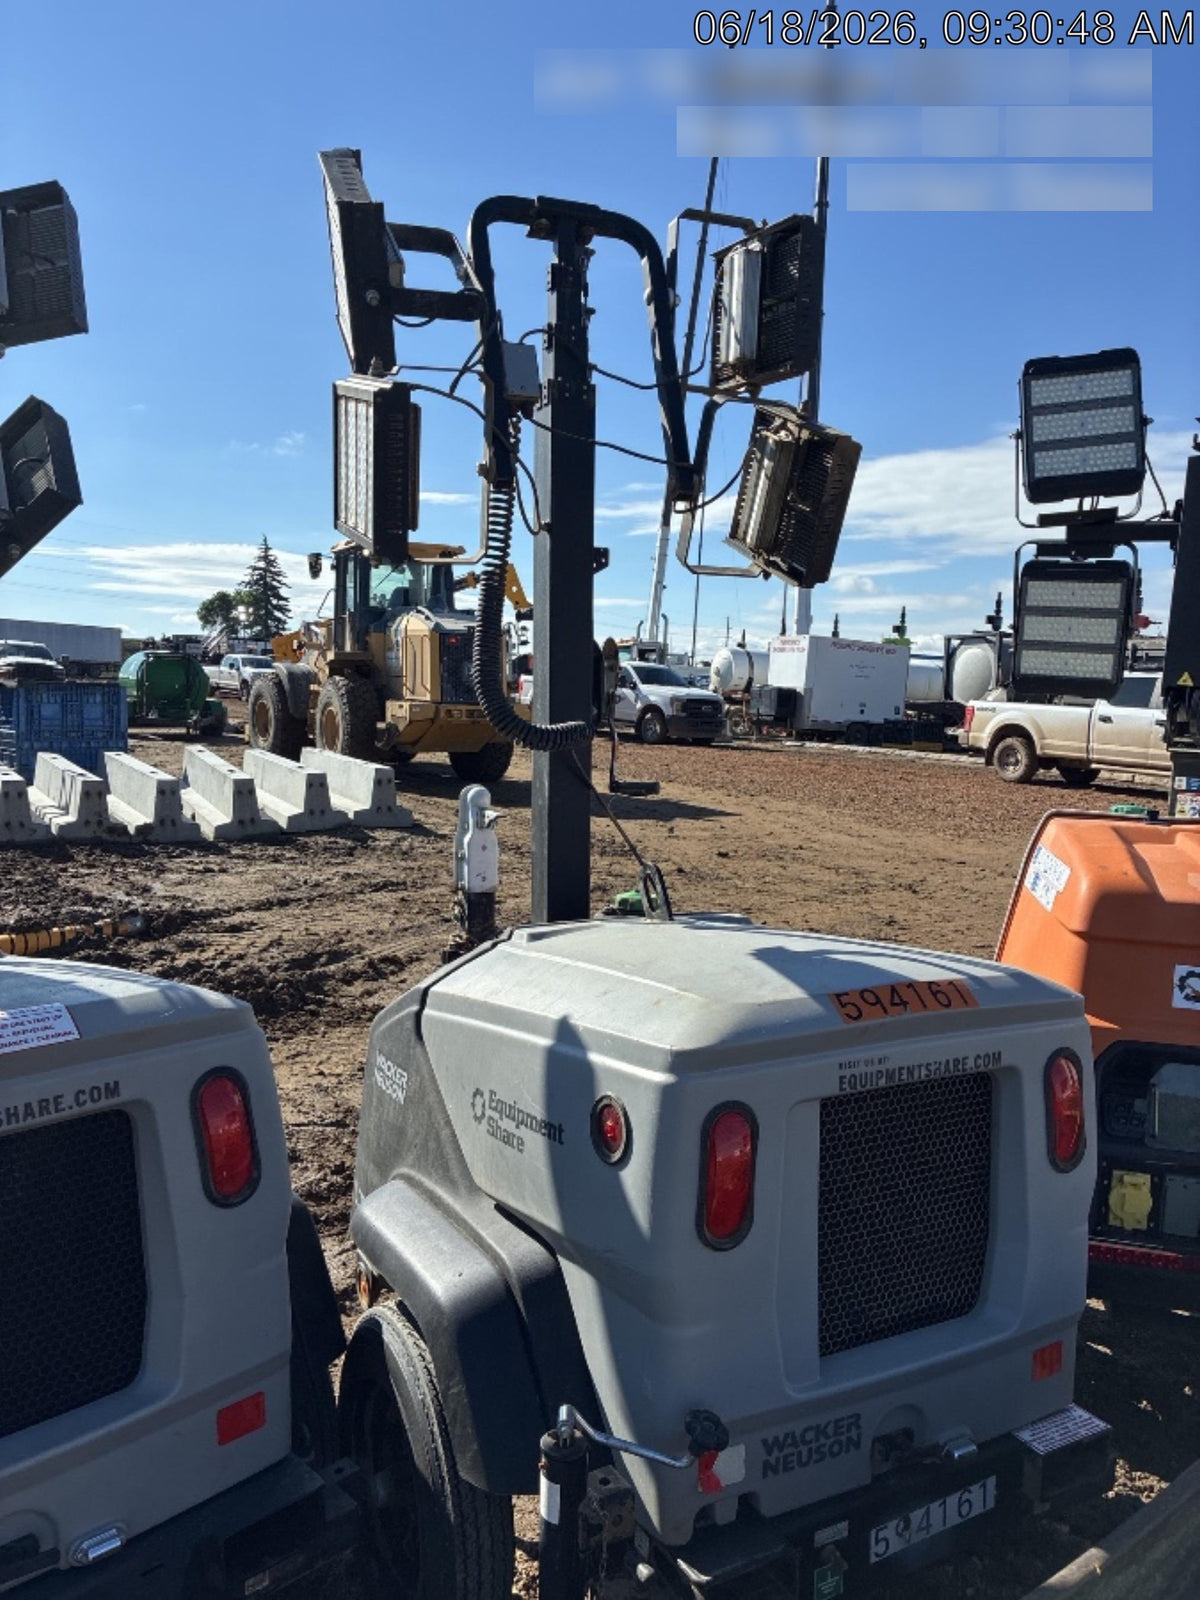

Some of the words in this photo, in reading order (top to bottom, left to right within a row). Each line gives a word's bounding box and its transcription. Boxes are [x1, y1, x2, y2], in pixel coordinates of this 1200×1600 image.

[834, 979, 969, 1021] 594161
[838, 1051, 1002, 1092] EQUIPMENTSHARE.COM
[486, 1117, 525, 1153] Share
[489, 1089, 565, 1145] Equipment
[760, 1412, 863, 1457] WACKER
[761, 1431, 864, 1480] NEUSON
